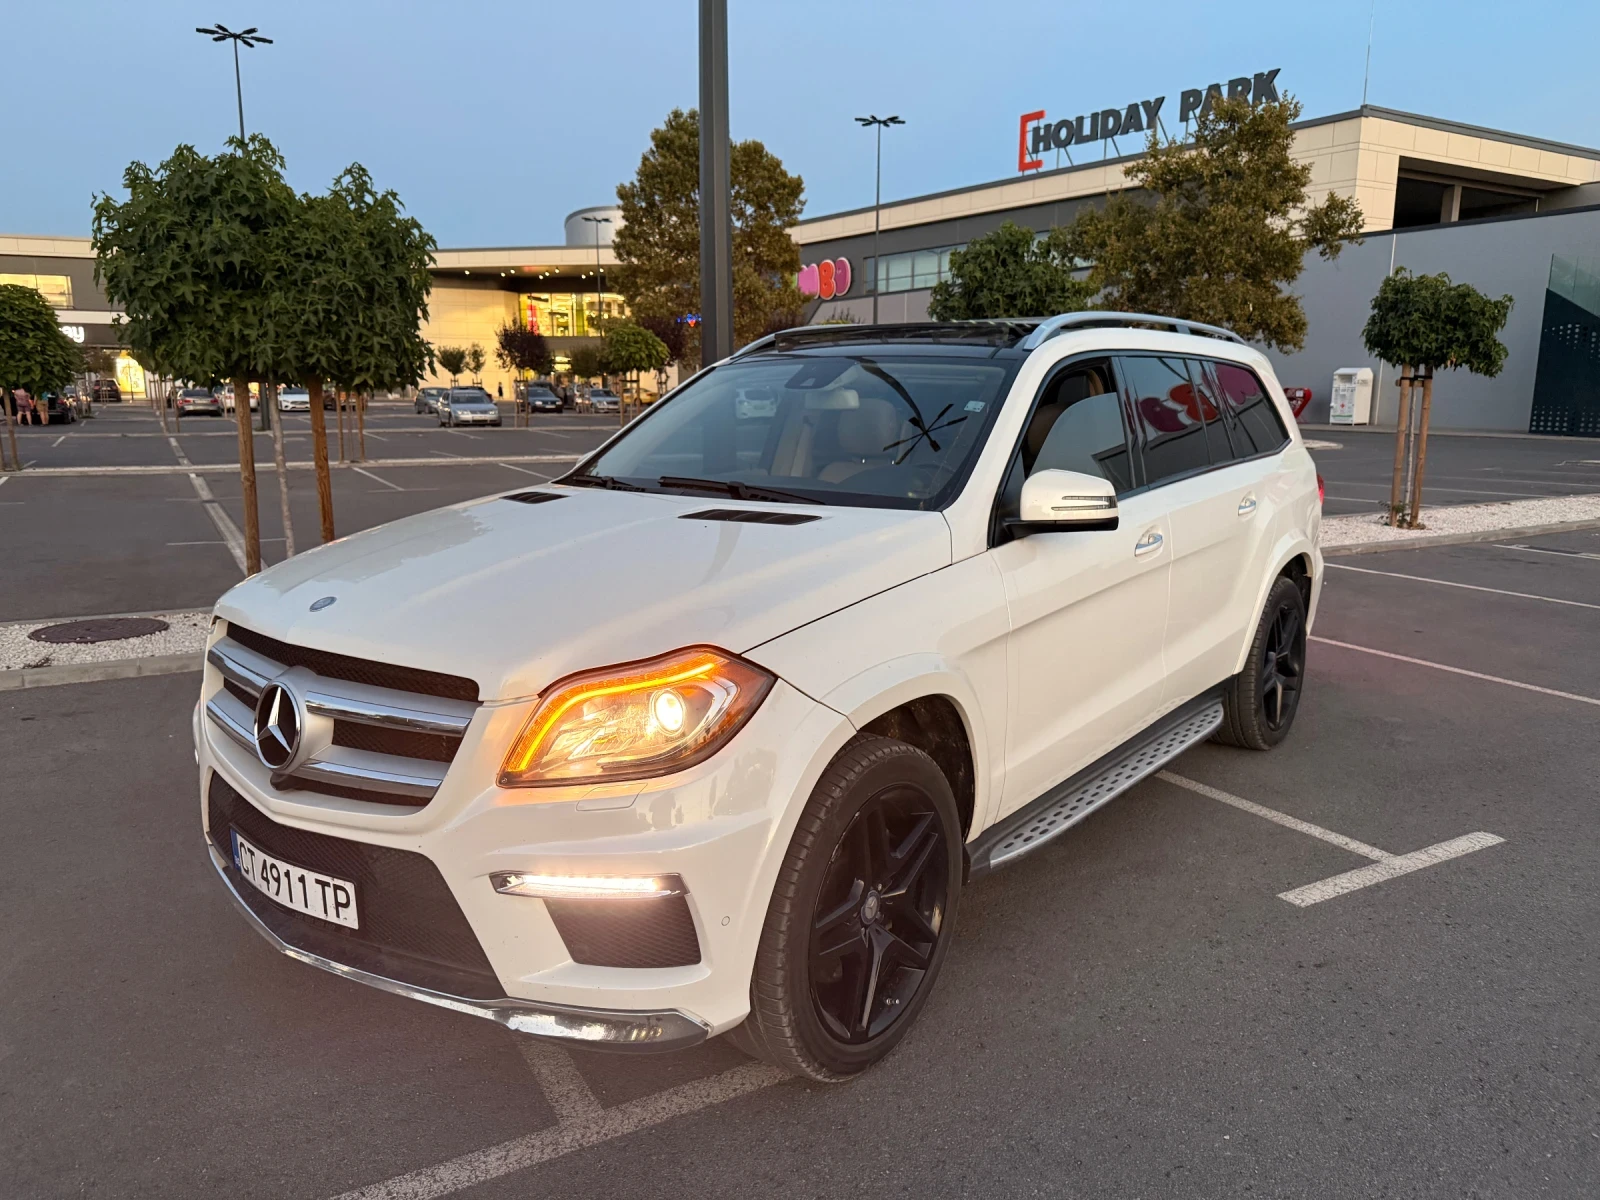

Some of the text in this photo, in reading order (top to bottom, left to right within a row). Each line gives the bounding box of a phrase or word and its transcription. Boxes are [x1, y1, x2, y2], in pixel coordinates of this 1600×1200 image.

[1032, 68, 1281, 154] HOLIDAY PARK
[260, 858, 309, 909] 4911
[314, 878, 351, 919] TP
